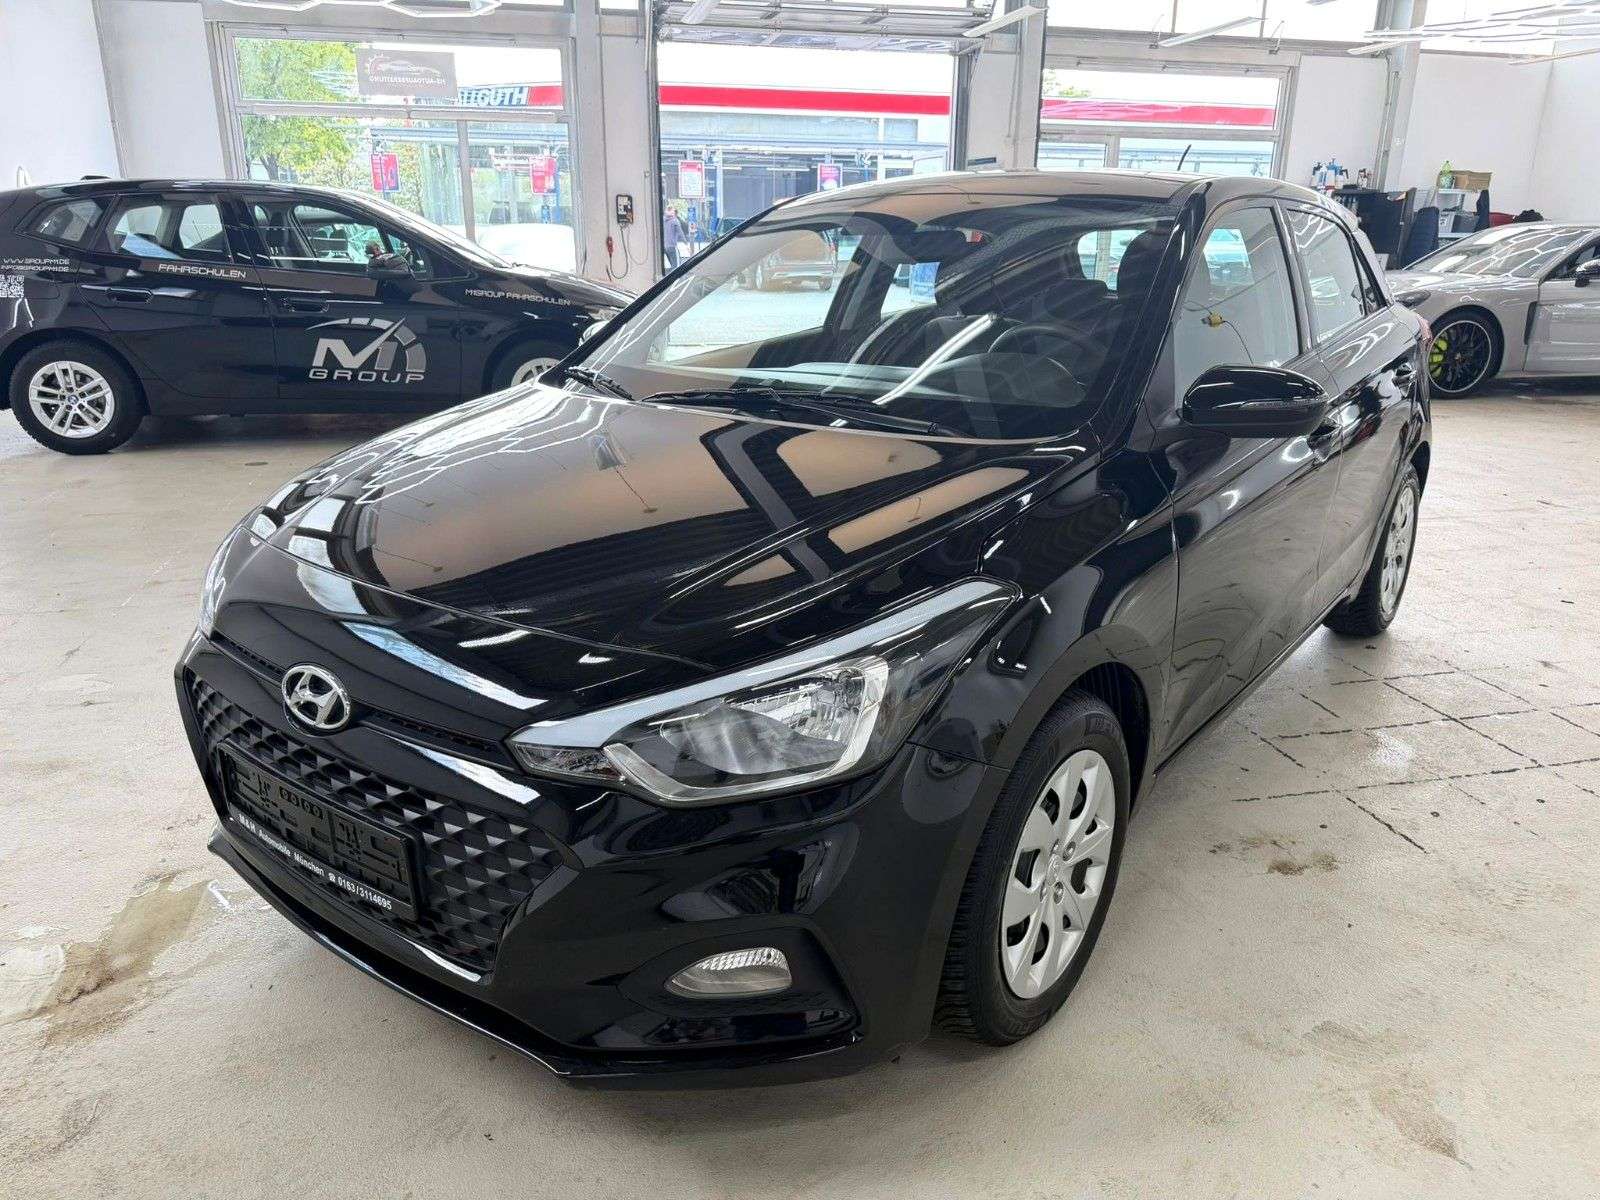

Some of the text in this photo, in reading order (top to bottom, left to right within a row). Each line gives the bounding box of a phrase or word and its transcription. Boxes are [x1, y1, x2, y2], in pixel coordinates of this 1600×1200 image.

[158, 263, 247, 279] FAHRSCHULEN
[506, 291, 571, 306] FAHRSCHULEN
[308, 367, 426, 385] GROUP
[258, 830, 291, 857] Automobile
[293, 852, 325, 877] München
